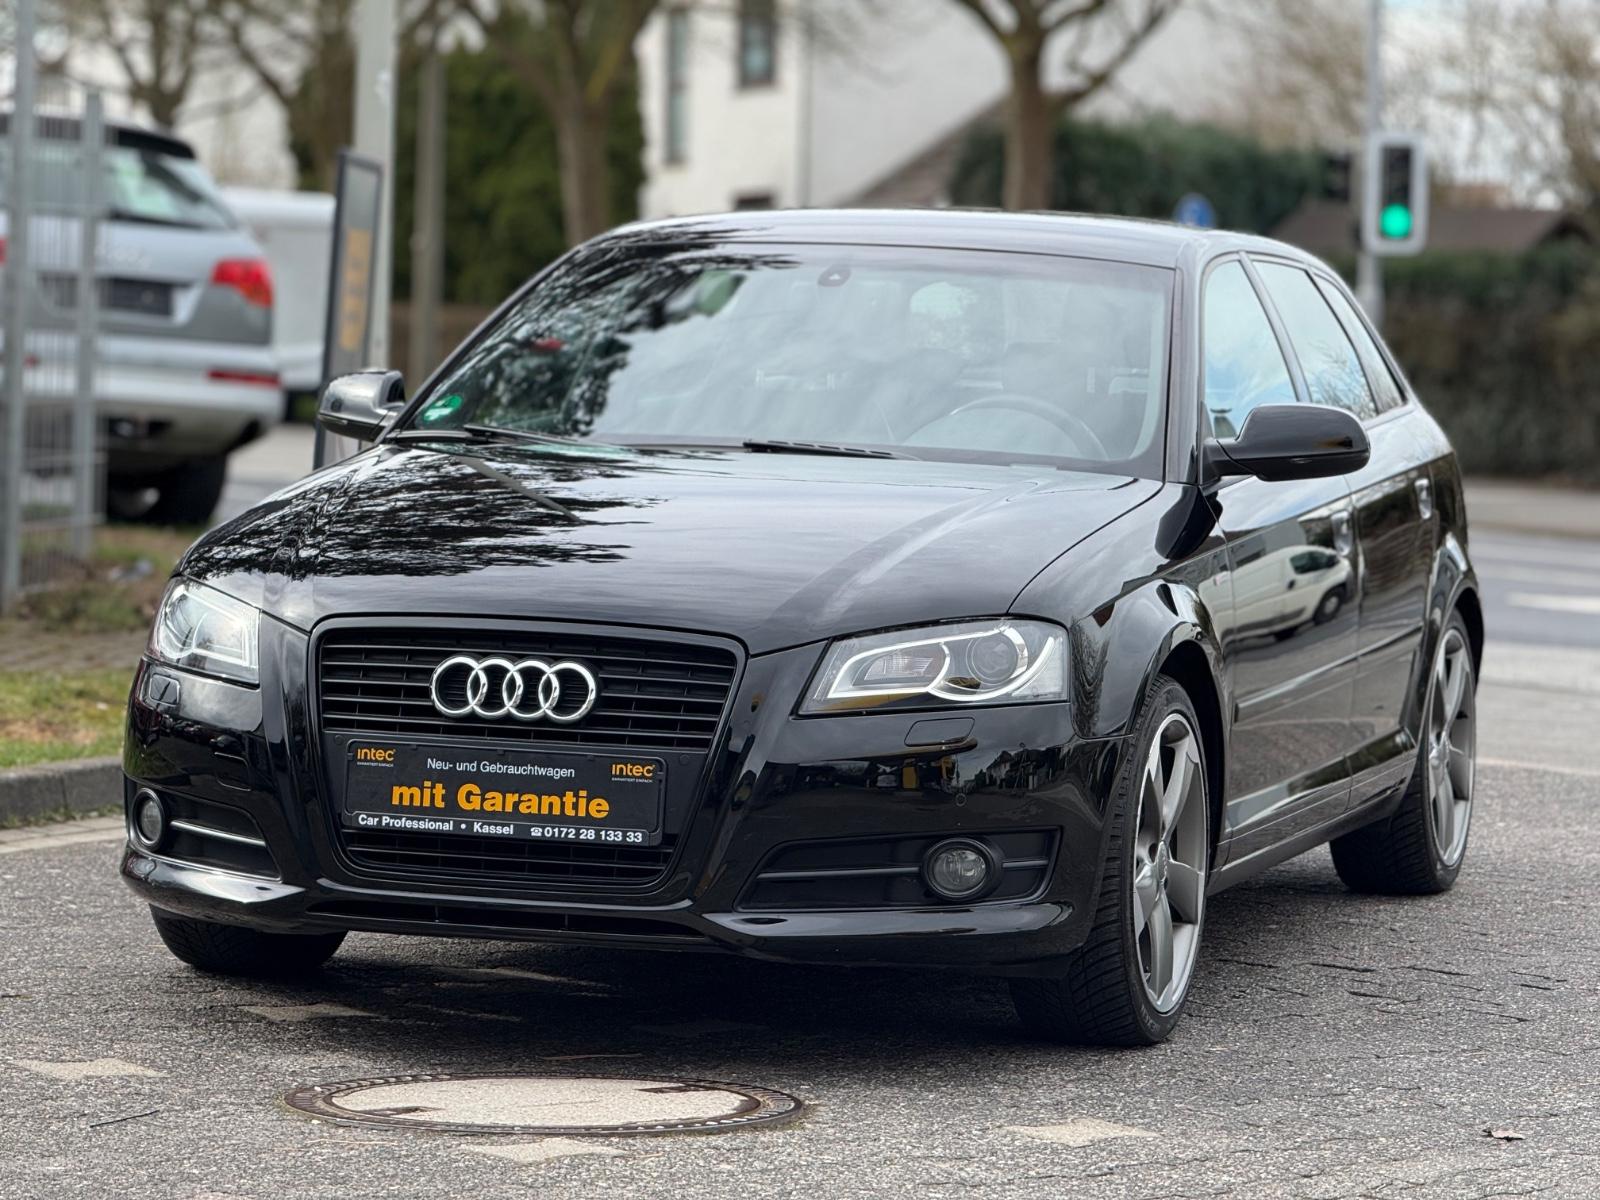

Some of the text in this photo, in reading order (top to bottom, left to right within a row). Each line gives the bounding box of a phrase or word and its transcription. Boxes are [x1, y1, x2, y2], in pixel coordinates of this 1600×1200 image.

[357, 747, 396, 761] intec
[427, 758, 575, 779] Neu- und Gebrauchtwagen
[611, 763, 656, 777] intec
[391, 781, 610, 818] mit Garantie
[358, 814, 514, 835] Car Professional Kassel
[544, 827, 643, 843] 0172 28 133 33
